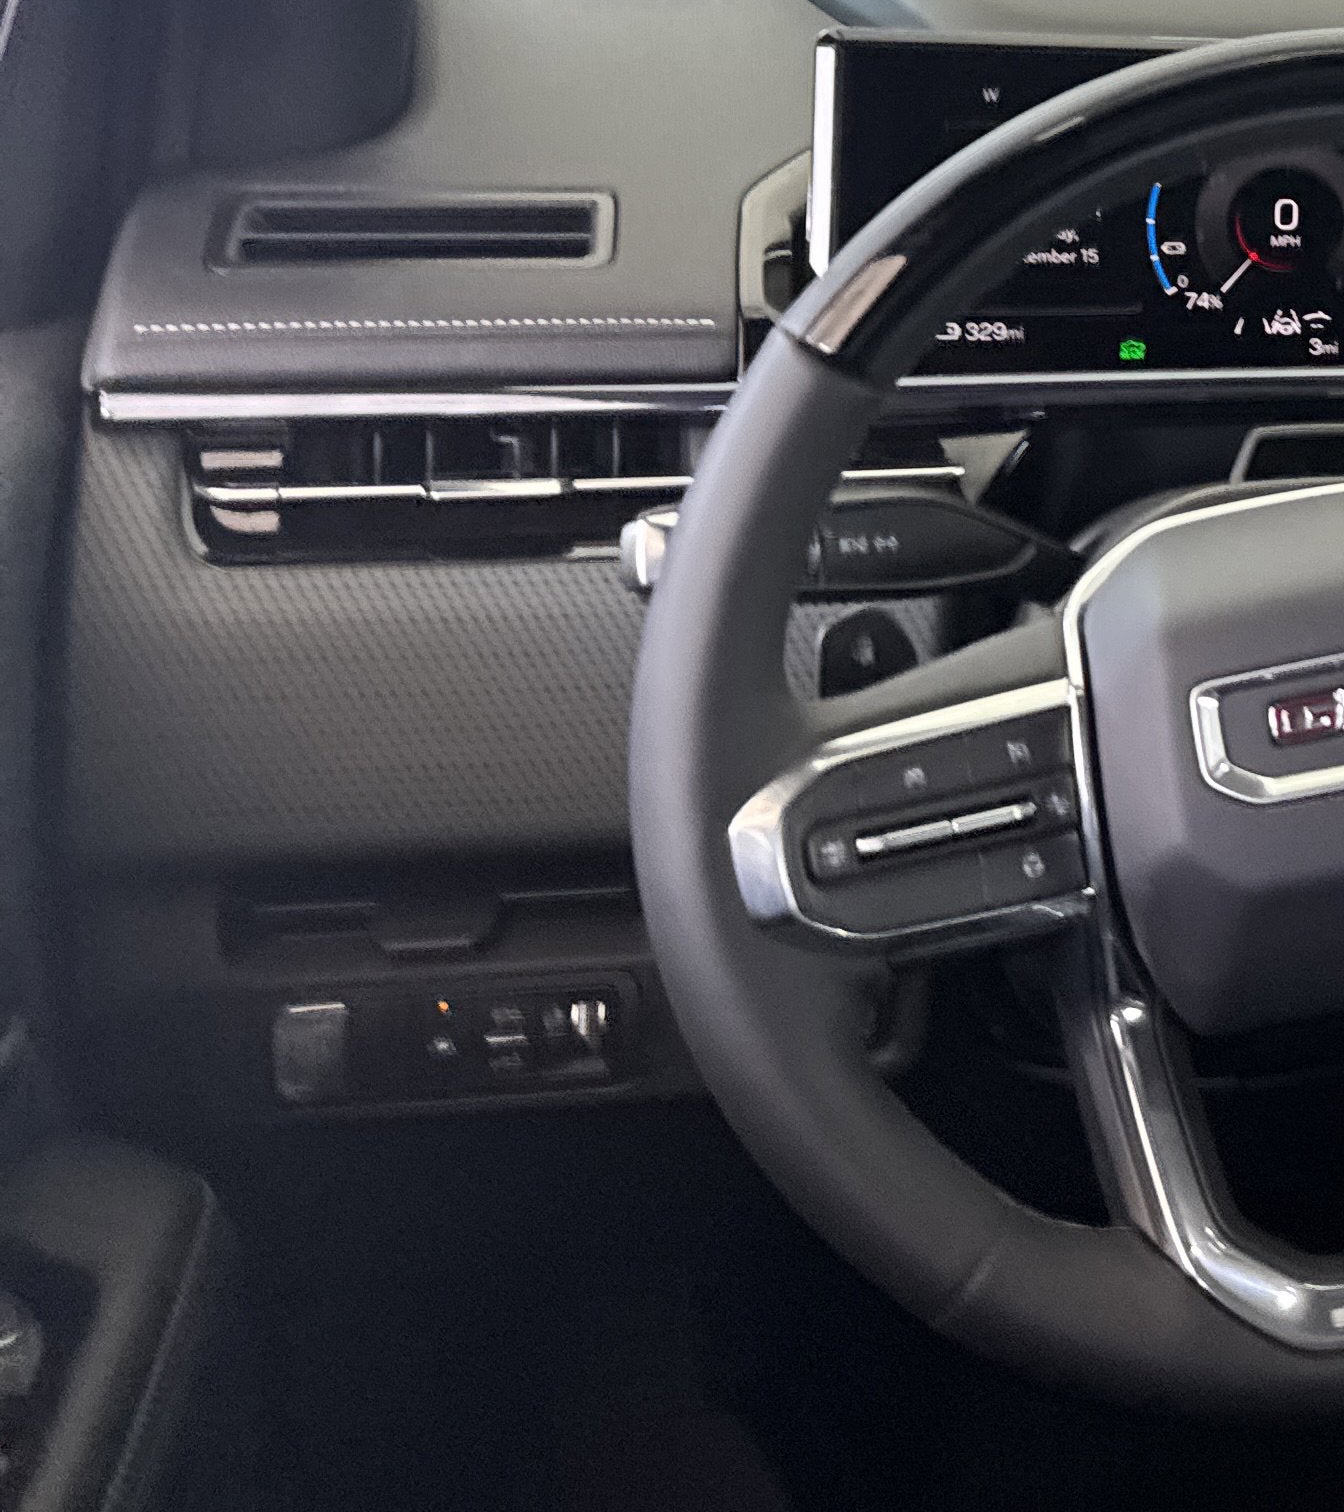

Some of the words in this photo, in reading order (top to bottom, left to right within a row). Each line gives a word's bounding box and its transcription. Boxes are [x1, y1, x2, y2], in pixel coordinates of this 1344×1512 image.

[982, 87, 1000, 103] W
[1273, 197, 1299, 231] 0
[1269, 234, 1302, 248] MPH
[1080, 247, 1100, 265] 15
[1183, 291, 1224, 310] 74%
